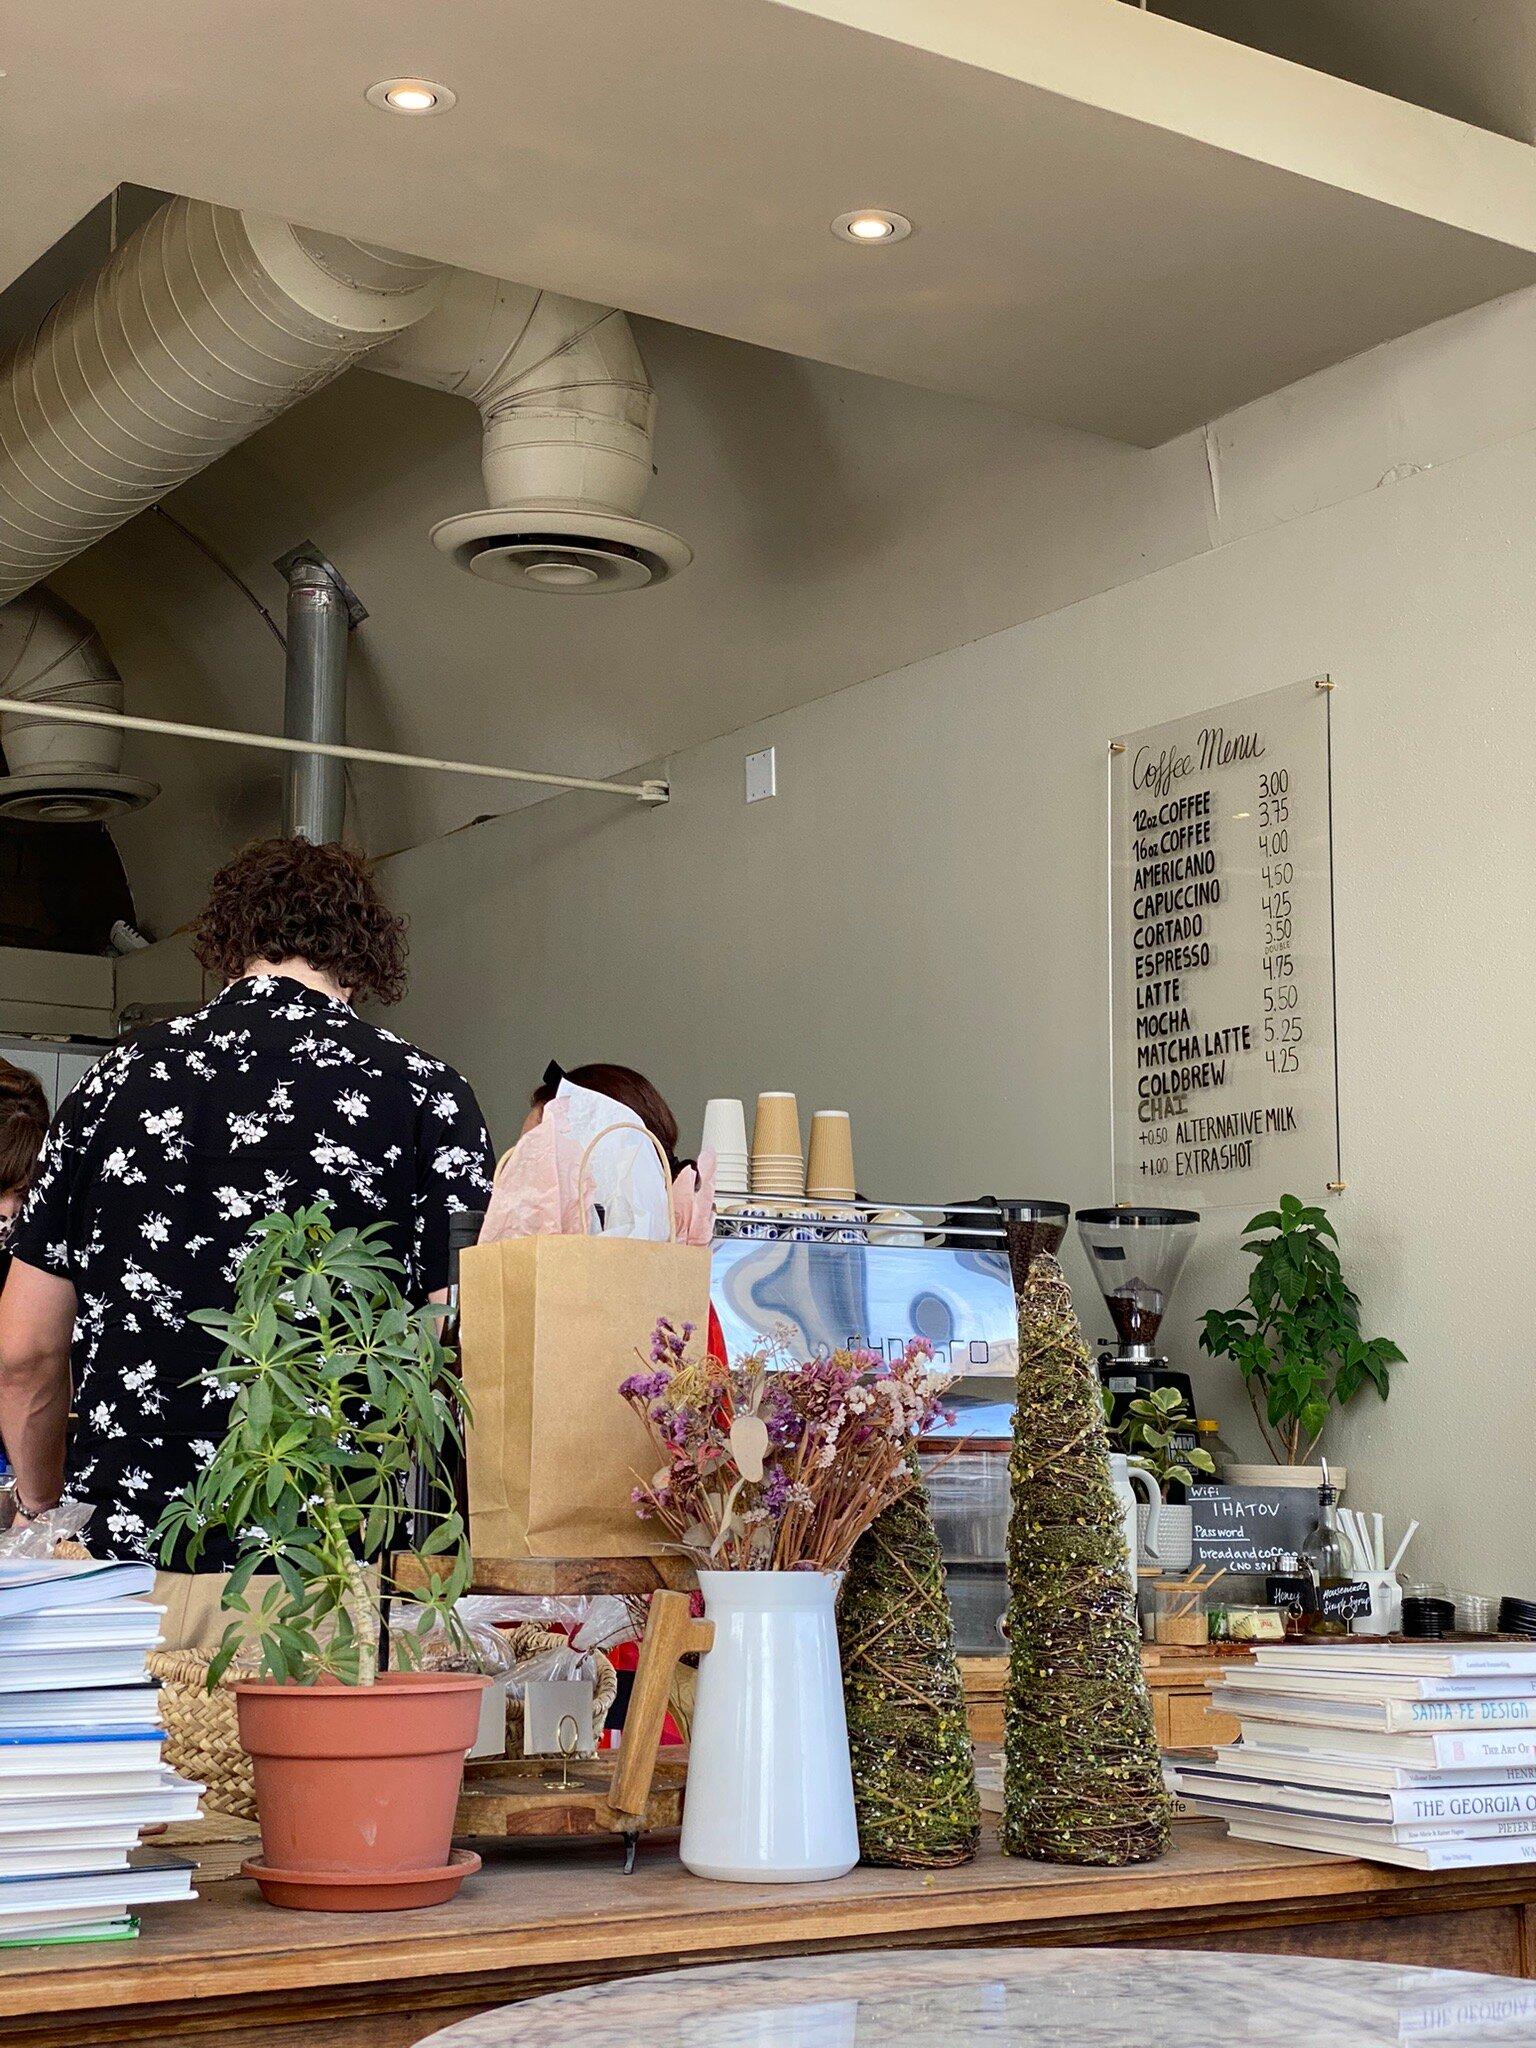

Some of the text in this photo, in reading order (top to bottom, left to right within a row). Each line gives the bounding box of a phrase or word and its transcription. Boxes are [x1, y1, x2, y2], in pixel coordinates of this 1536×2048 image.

[1132, 727, 1266, 798] Coffee Menu
[1158, 790, 1211, 825] COFFEE
[1259, 768, 1289, 799] 3.00
[1159, 819, 1211, 854] COFFEE
[1259, 797, 1289, 828] 3.75
[1133, 829, 1288, 892] AMERICANO 4.00
[1133, 862, 1294, 920] CAPUCCINO 4.50
[1133, 890, 1292, 949] CORTADO 4.25
[1135, 918, 1292, 979] ESPRESSO 3.50
[1136, 953, 1294, 1010] LATTE 4.75
[1136, 984, 1298, 1040] MOCHA 5.50
[1137, 1016, 1303, 1069] MATCHA LATTE 5.25
[1265, 1046, 1299, 1074] 4.25
[1137, 1093, 1188, 1123] CHAI
[1138, 1106, 1297, 1146] +0.50 ALTERNATIVE MILK
[1139, 1157, 1169, 1176] +1.00
[1190, 1486, 1219, 1498] Wifi
[1194, 1525, 1245, 1538] Password
[1273, 1587, 1300, 1608] Honey
[1411, 1701, 1529, 1721] SANTA FE DESIGN
[1505, 1767, 1536, 1780] HENR
[1169, 1800, 1187, 1812] ffe
[1413, 1799, 1445, 1817] THE
[1449, 1796, 1521, 1816] GEORGIA
[1498, 1821, 1529, 1835] PIETER
